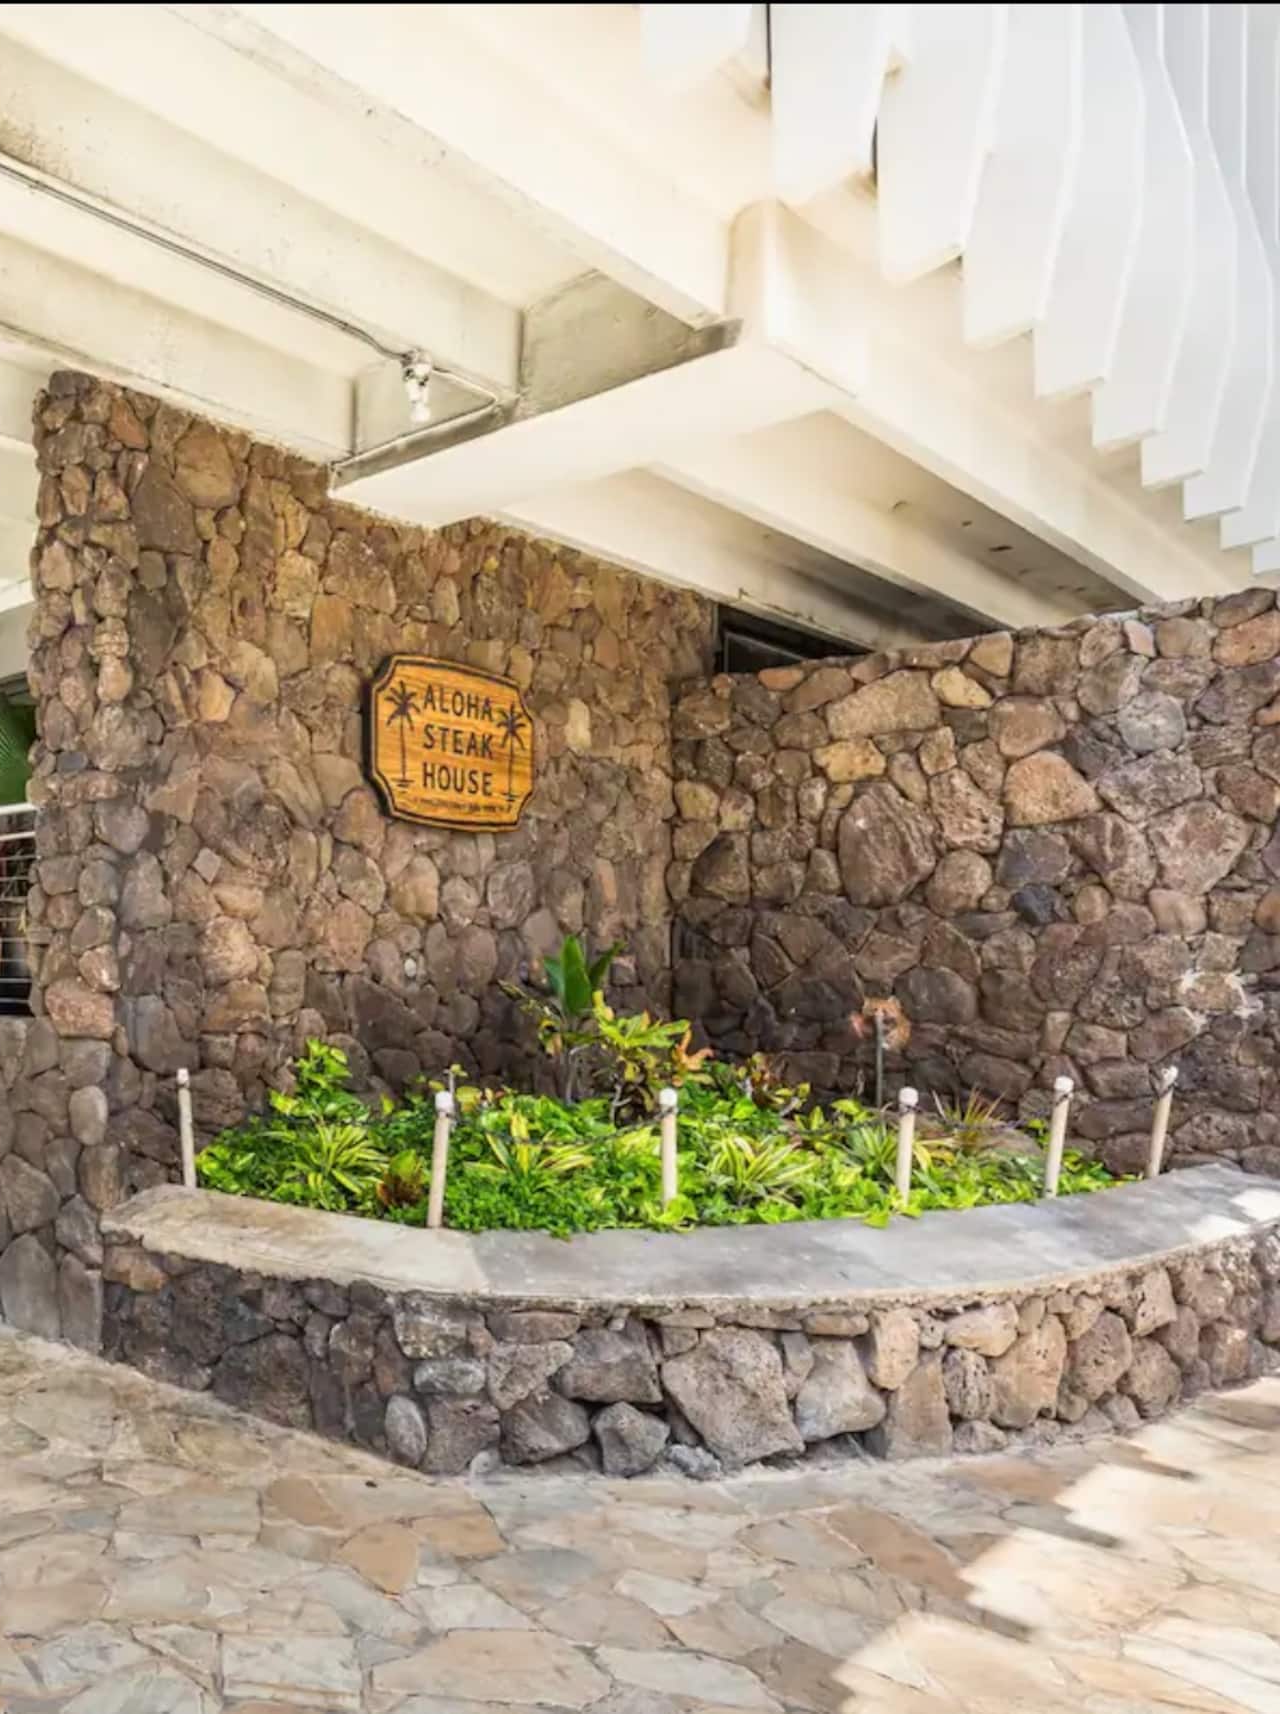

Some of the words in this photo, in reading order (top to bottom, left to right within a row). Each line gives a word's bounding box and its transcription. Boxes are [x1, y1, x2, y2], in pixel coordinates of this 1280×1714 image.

[423, 684, 494, 721] ALOHA
[423, 723, 494, 760] STEAK
[422, 761, 493, 796] HOUSE
